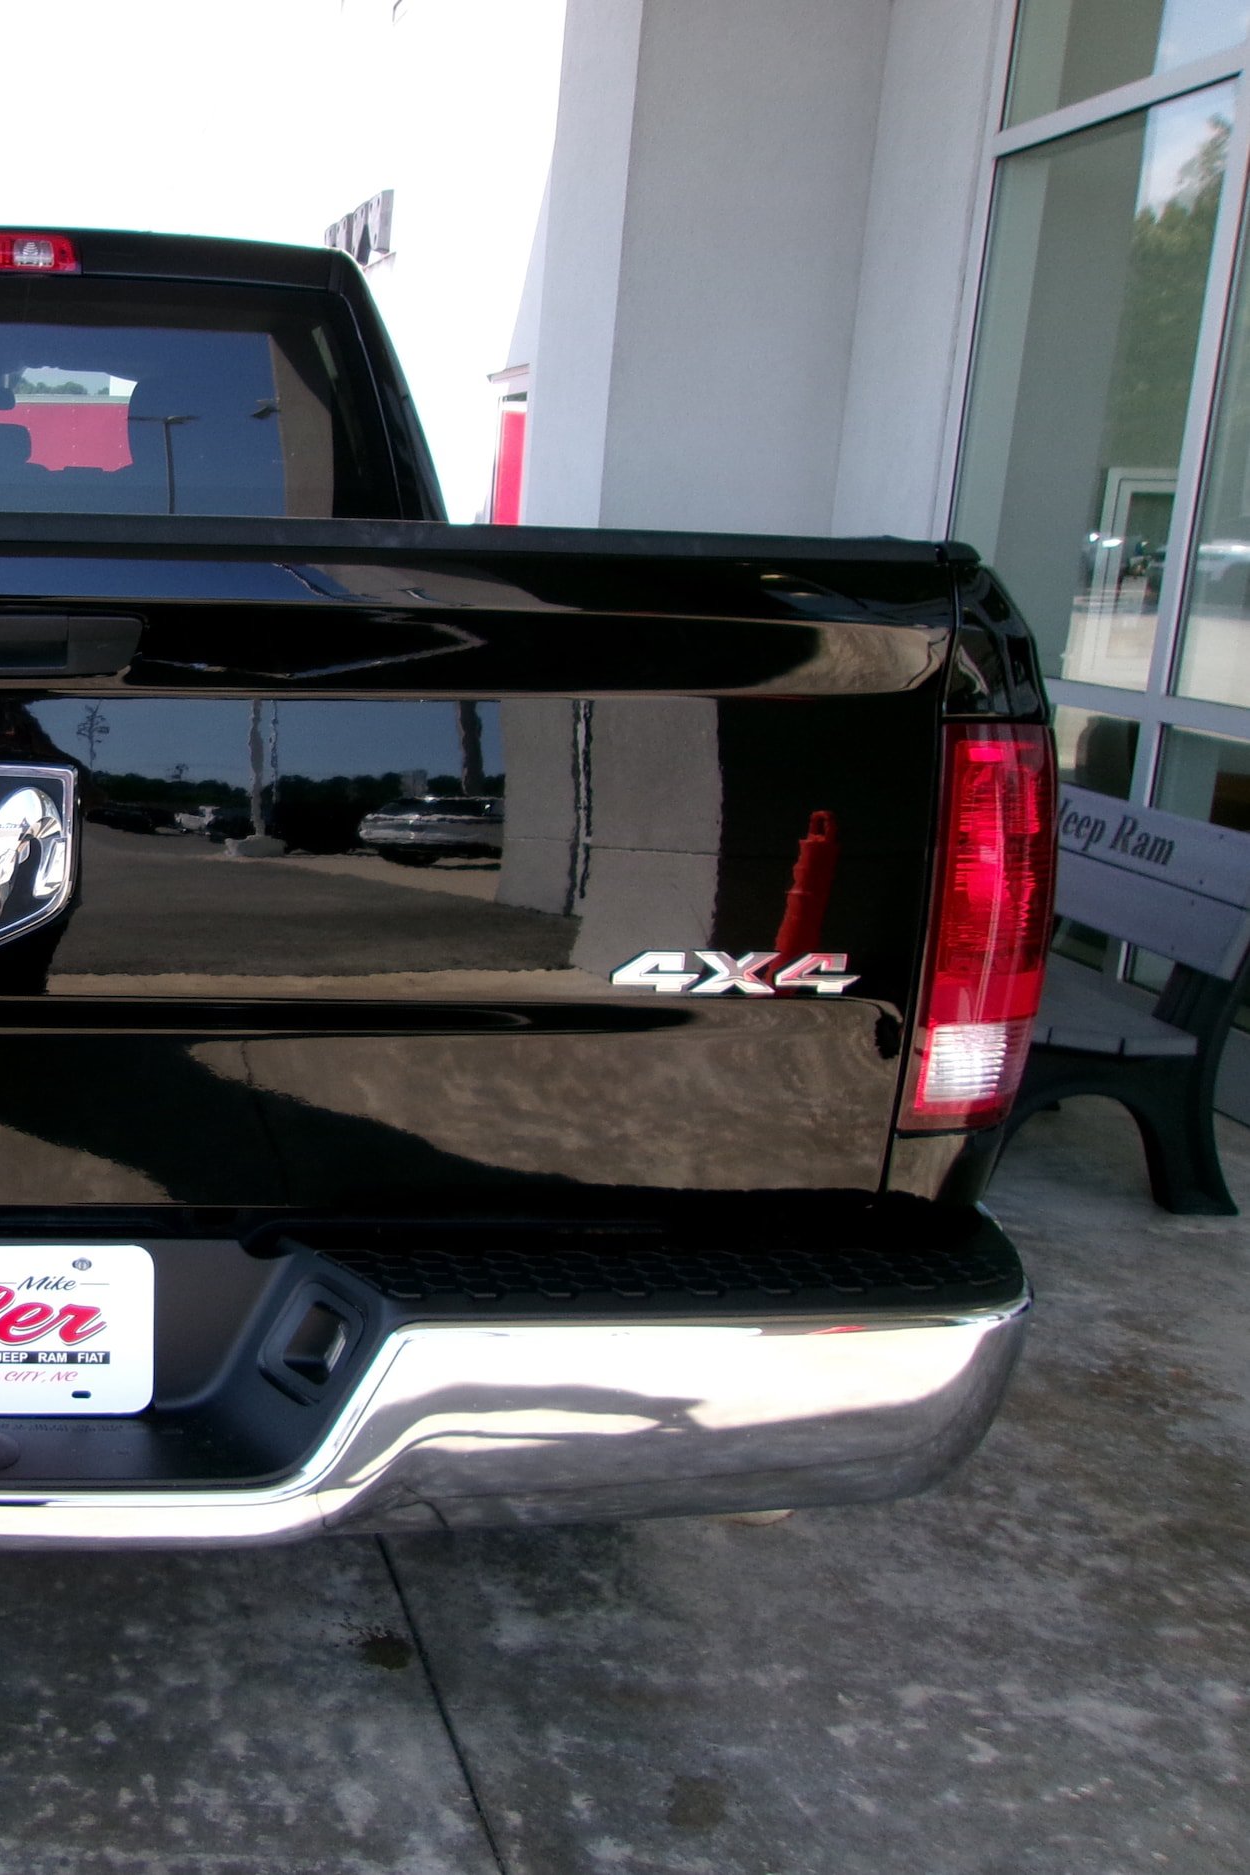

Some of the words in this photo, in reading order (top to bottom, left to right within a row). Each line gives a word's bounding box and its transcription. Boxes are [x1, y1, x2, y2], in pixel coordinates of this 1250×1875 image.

[1109, 814, 1175, 866] Ram
[17, 1275, 79, 1293] Mike
[37, 1350, 68, 1364] RAM
[77, 1350, 105, 1364] FIAT
[52, 1370, 79, 1382] NC
